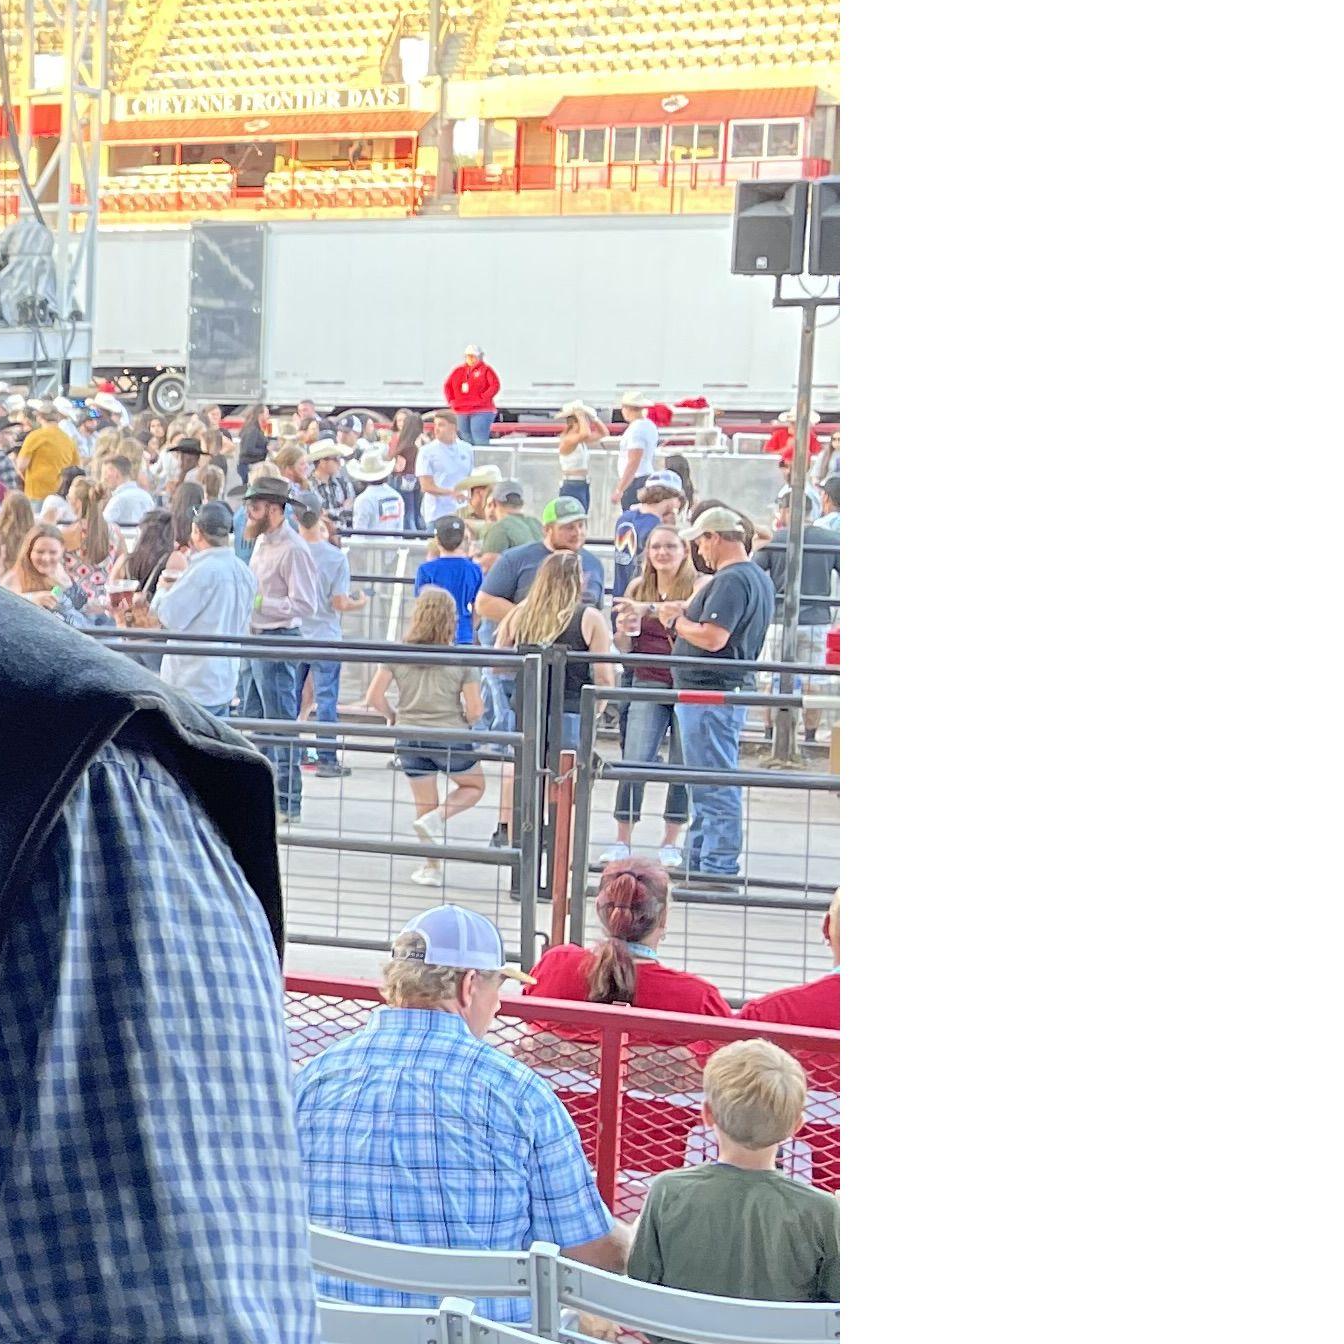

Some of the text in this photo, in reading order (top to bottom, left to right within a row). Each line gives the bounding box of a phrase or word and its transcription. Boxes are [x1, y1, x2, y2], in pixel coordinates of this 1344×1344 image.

[131, 86, 400, 116] CHEYENNE FRONTIER DAYS
